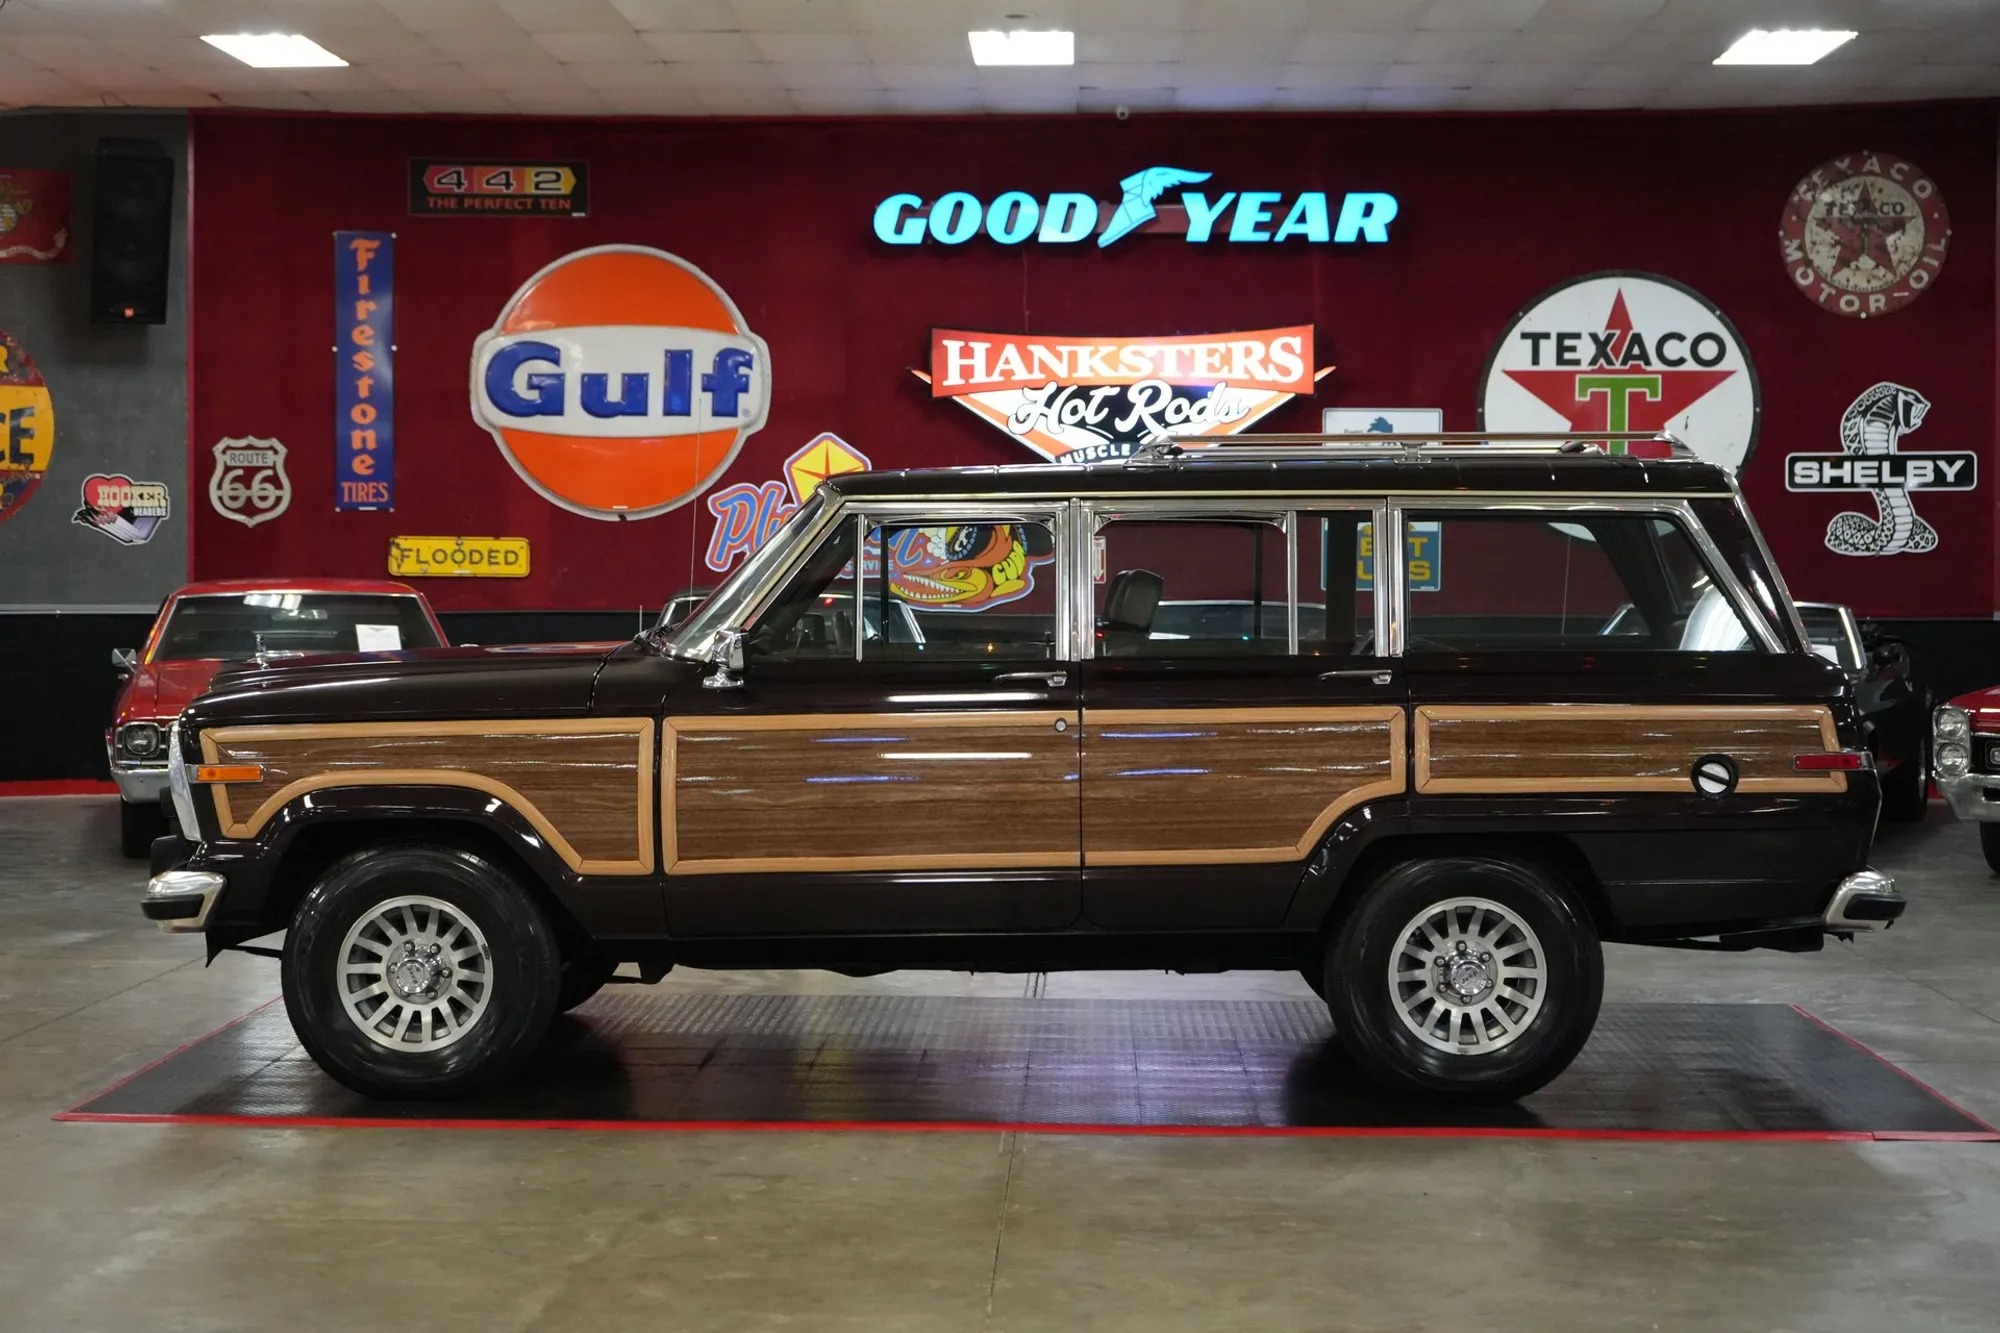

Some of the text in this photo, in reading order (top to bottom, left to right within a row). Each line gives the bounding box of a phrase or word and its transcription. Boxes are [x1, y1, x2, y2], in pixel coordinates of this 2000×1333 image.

[426, 197, 571, 209] THE PERFECT TEN
[873, 190, 1398, 245] GOOD YEAR
[349, 238, 381, 476] Firestone
[942, 335, 1303, 386] HANKSTERS
[1520, 331, 1727, 367] TEXACO
[485, 340, 754, 419] Gulf
[1007, 380, 1252, 437] Hot Rods
[228, 451, 269, 465] ROUTE
[1060, 443, 1131, 464] MUSCLE
[1793, 459, 1966, 484] SHELBY
[97, 485, 167, 508] HOOKER
[221, 469, 275, 509] 66
[341, 482, 389, 503] TIRES
[399, 547, 519, 567] FLOODED
